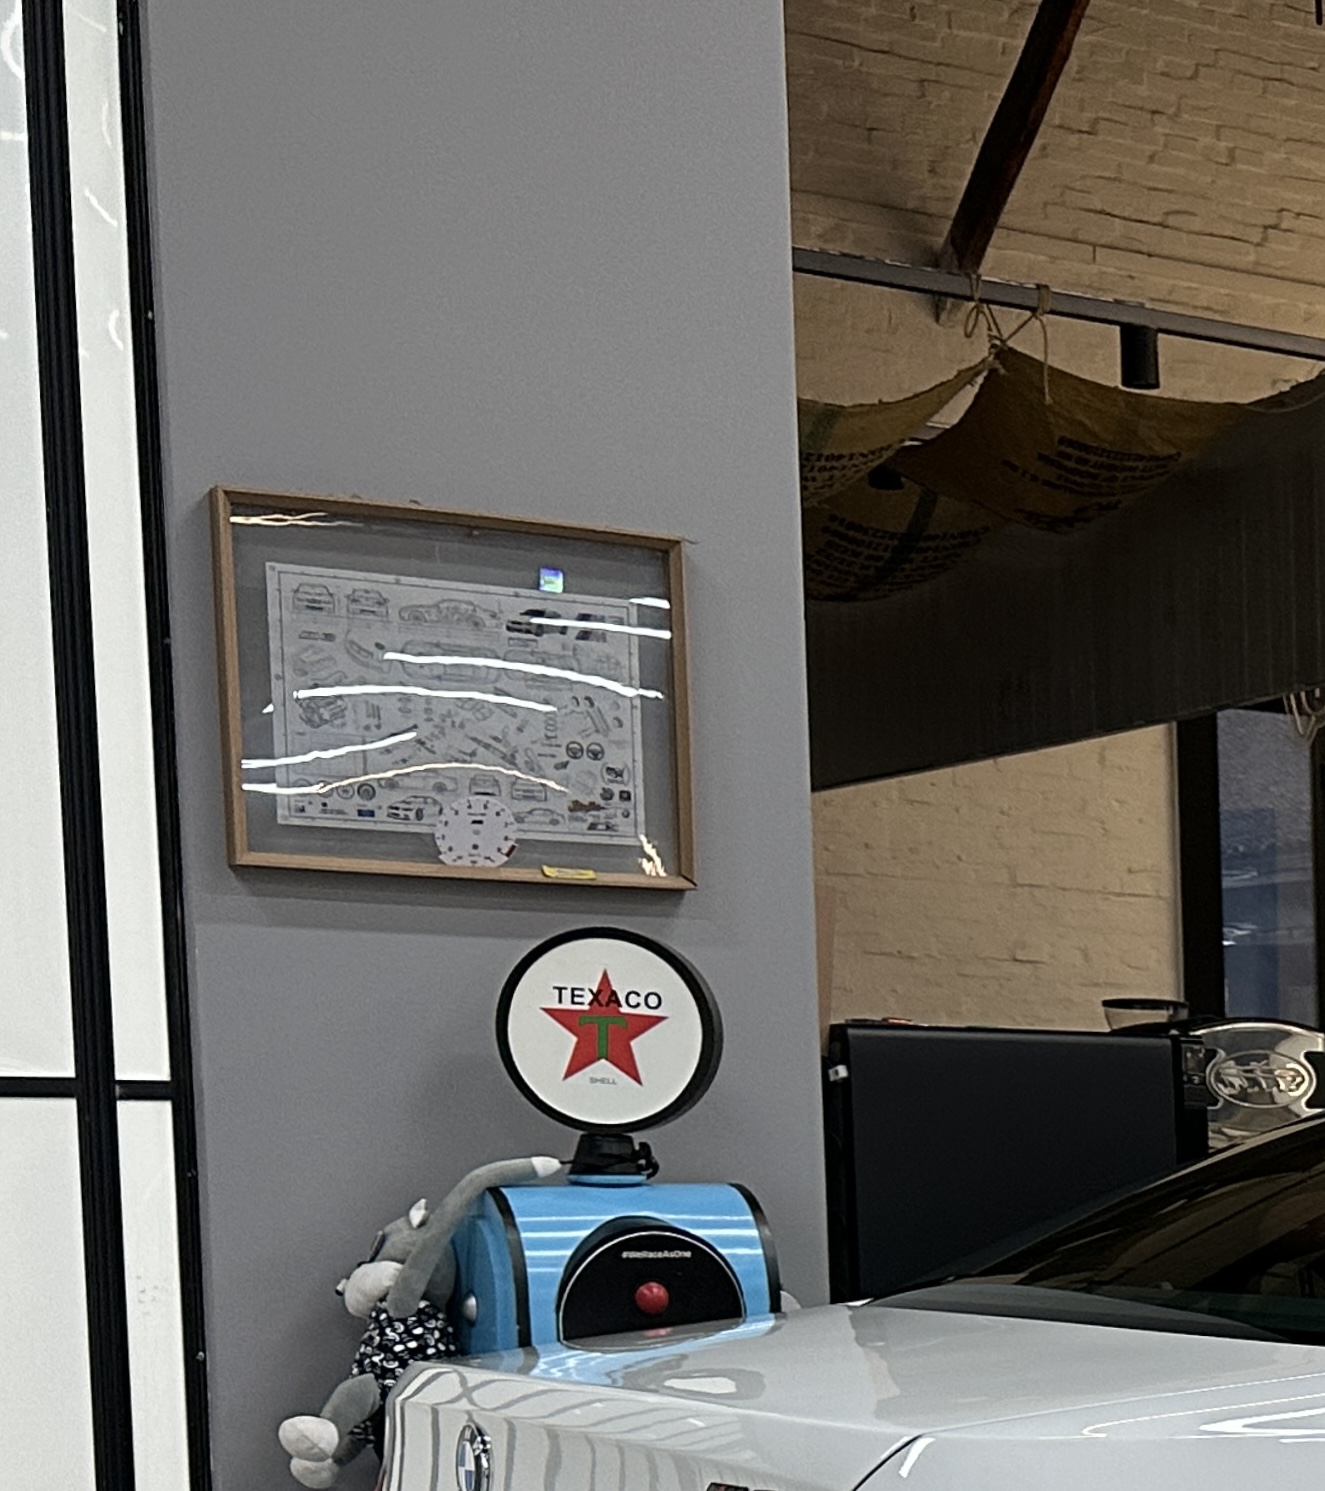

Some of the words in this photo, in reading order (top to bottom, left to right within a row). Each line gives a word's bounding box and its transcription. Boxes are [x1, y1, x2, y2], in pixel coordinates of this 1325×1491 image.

[552, 985, 663, 1010] TEXACO
[578, 1015, 629, 1060] T
[589, 1076, 617, 1086] SHELL
